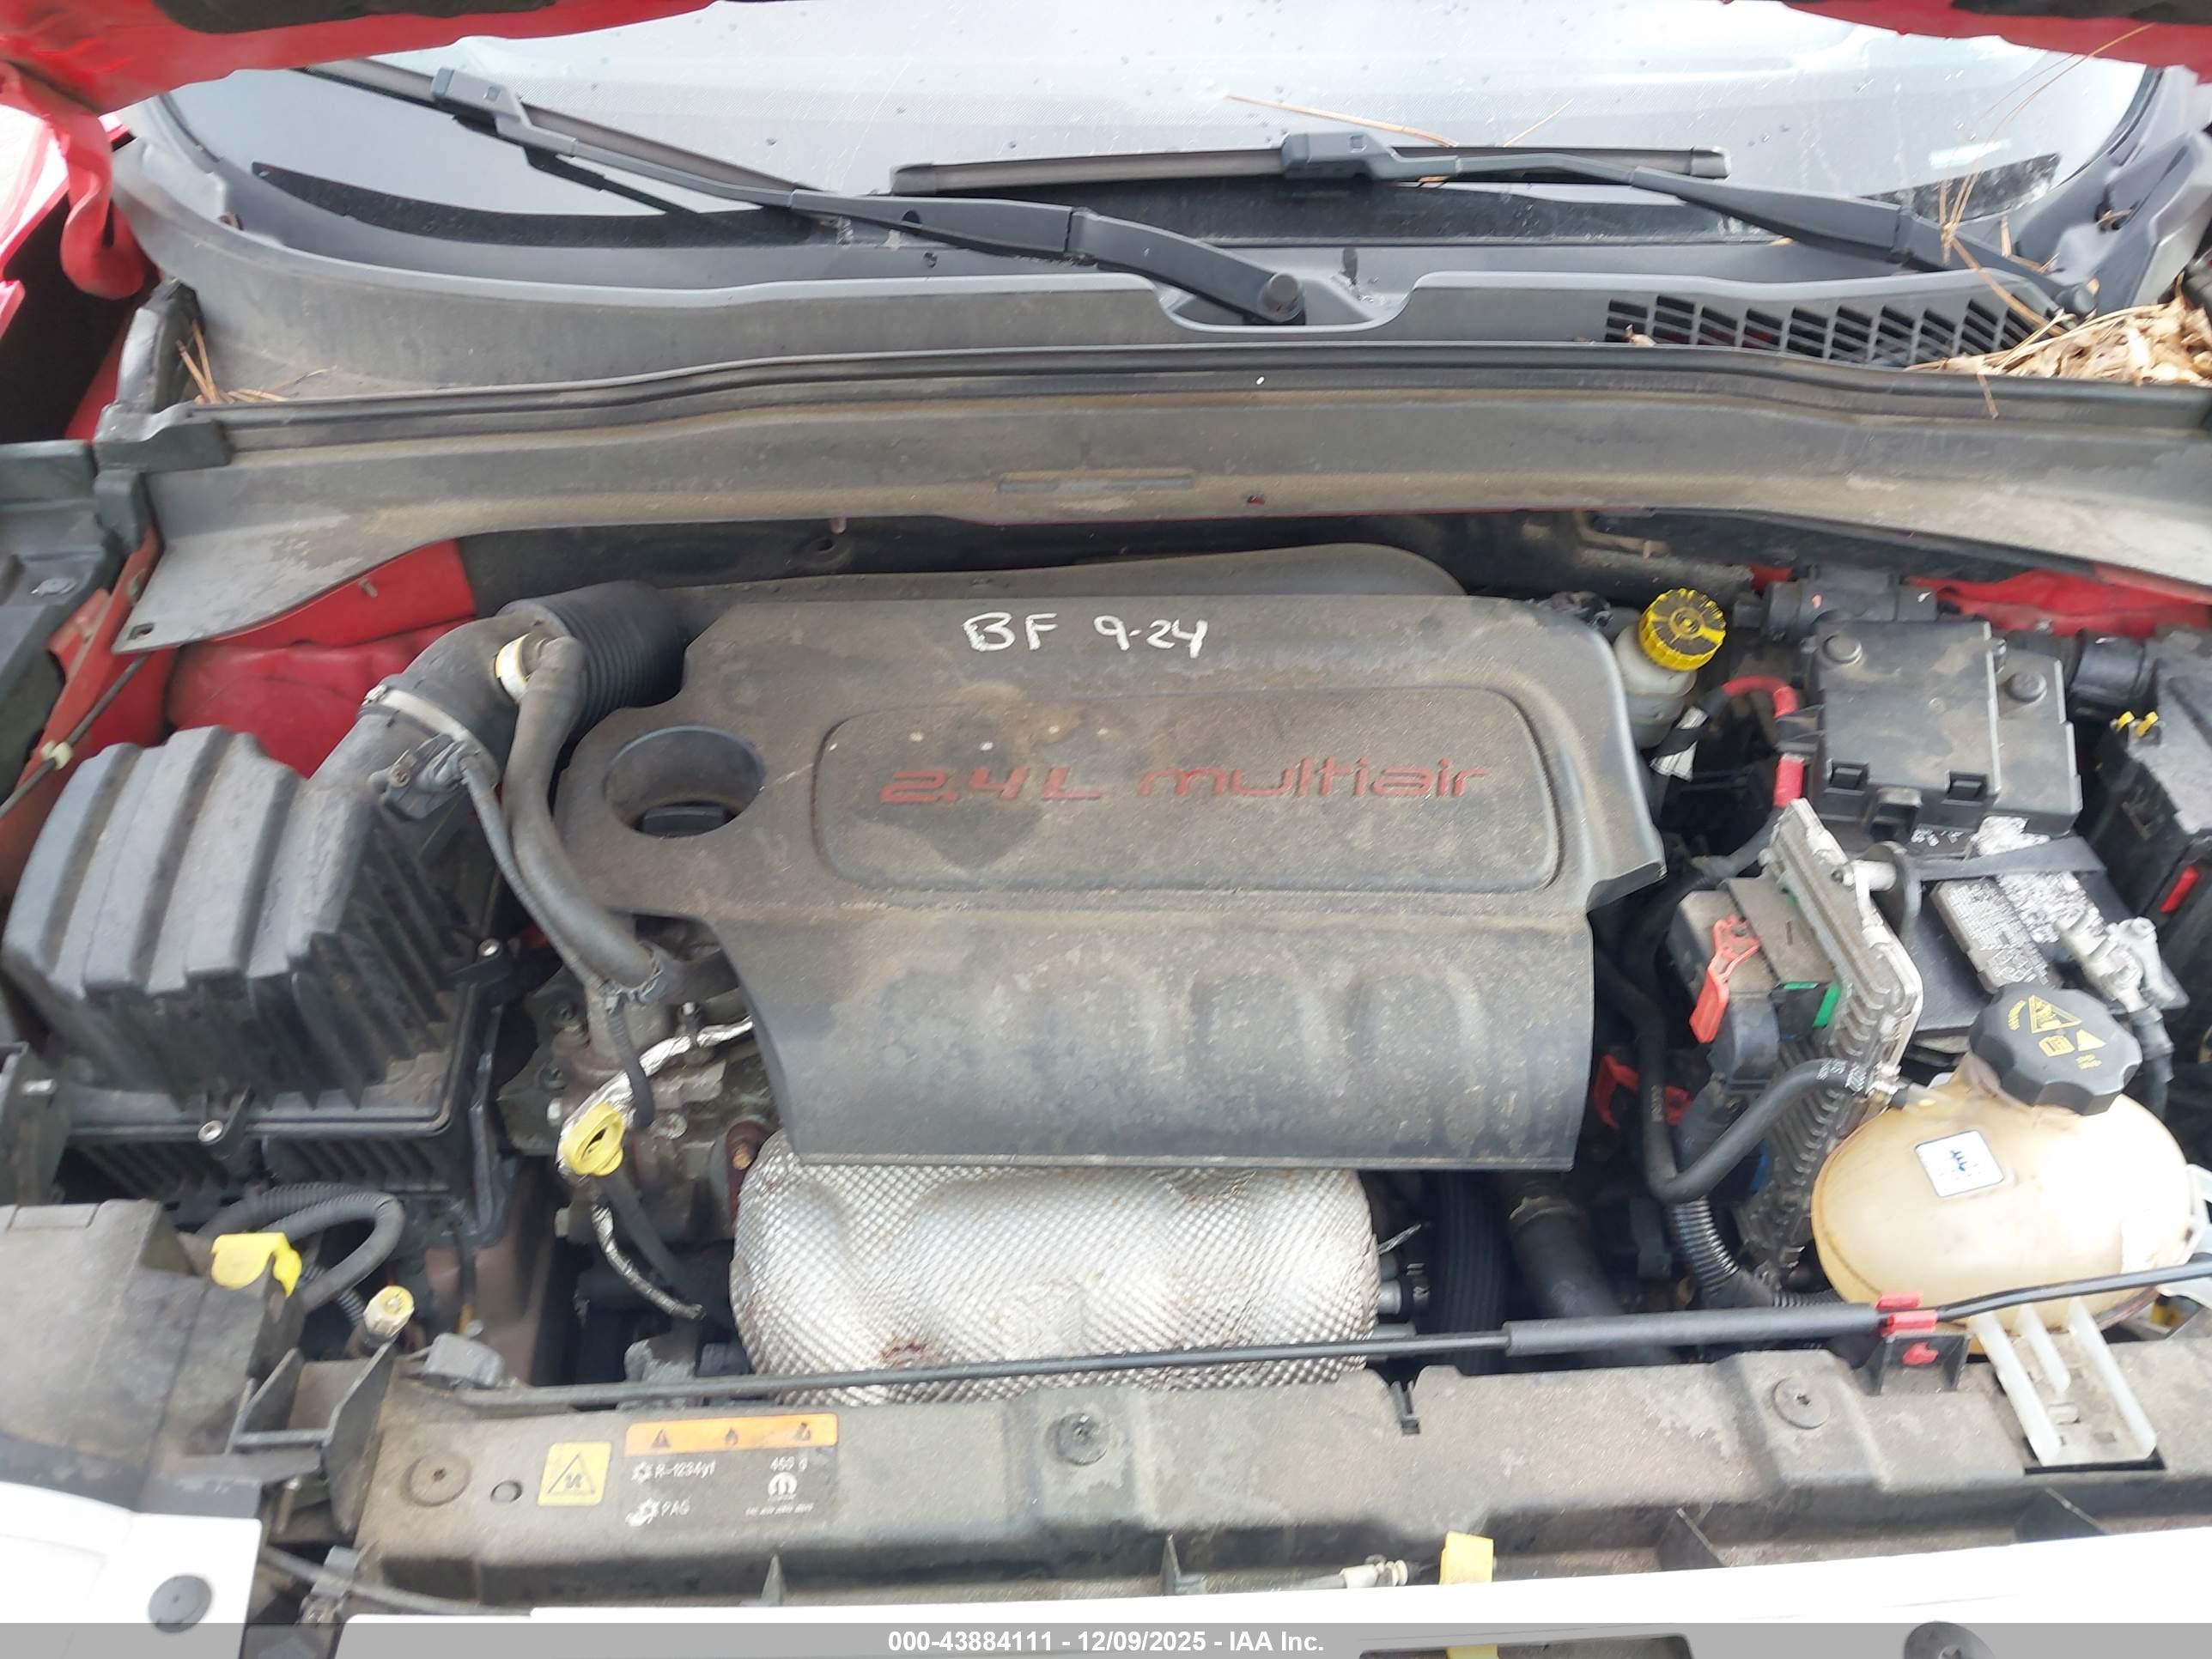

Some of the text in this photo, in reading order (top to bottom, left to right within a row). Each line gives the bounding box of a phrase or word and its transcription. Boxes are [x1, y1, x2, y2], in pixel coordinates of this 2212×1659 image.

[962, 611, 1210, 659] BF 9-24
[879, 755, 1487, 804] 2.4L multiair
